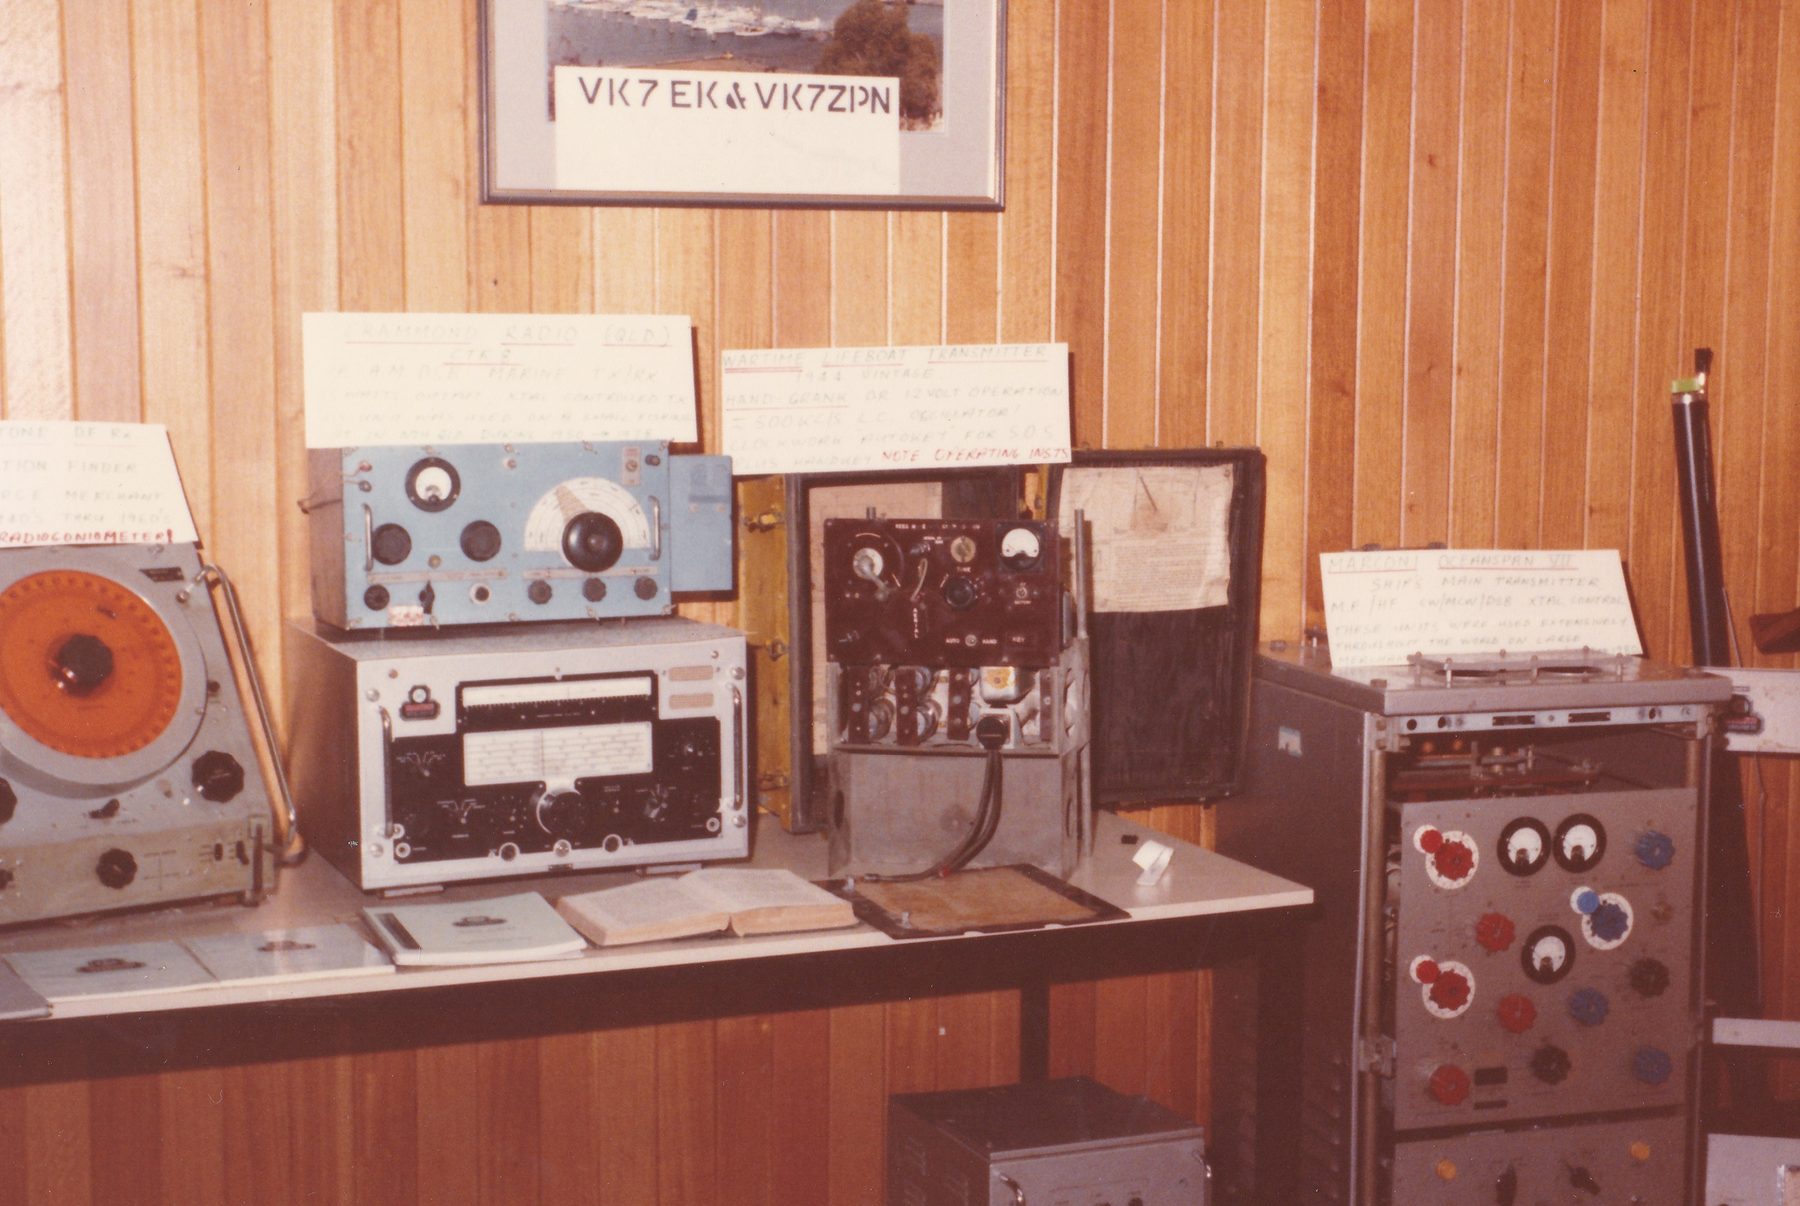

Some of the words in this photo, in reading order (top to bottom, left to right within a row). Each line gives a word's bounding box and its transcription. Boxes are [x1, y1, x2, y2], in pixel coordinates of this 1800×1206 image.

[505, 325, 577, 342] RADIO
[603, 325, 671, 344] (QLD)
[724, 354, 803, 368] WARTIME
[822, 350, 904, 364] LIFEBOAT
[927, 346, 1048, 362] TRANSMITTER
[489, 367, 563, 382] MARINE
[864, 389, 889, 401] OR
[967, 386, 1062, 398] OPERATION
[964, 430, 997, 440] FOR
[881, 450, 920, 463] NOTE
[933, 447, 1020, 461] OPERATING
[68, 460, 137, 473] FINDER
[1328, 556, 1418, 571] MARCONI
[1438, 555, 1534, 568] OCEANSPAN
[1440, 577, 1482, 587] MAIN
[1495, 576, 1599, 587] TRANSMITTER
[1334, 623, 1380, 636] THESE
[1448, 620, 1487, 631] WERE
[1497, 619, 1531, 629] USED
[1540, 617, 1627, 628] EXTENSIVELY
[1429, 637, 1450, 647] THE
[1459, 636, 1497, 646] WORLD
[1507, 636, 1527, 646] ON
[1535, 634, 1579, 646] LARGE
